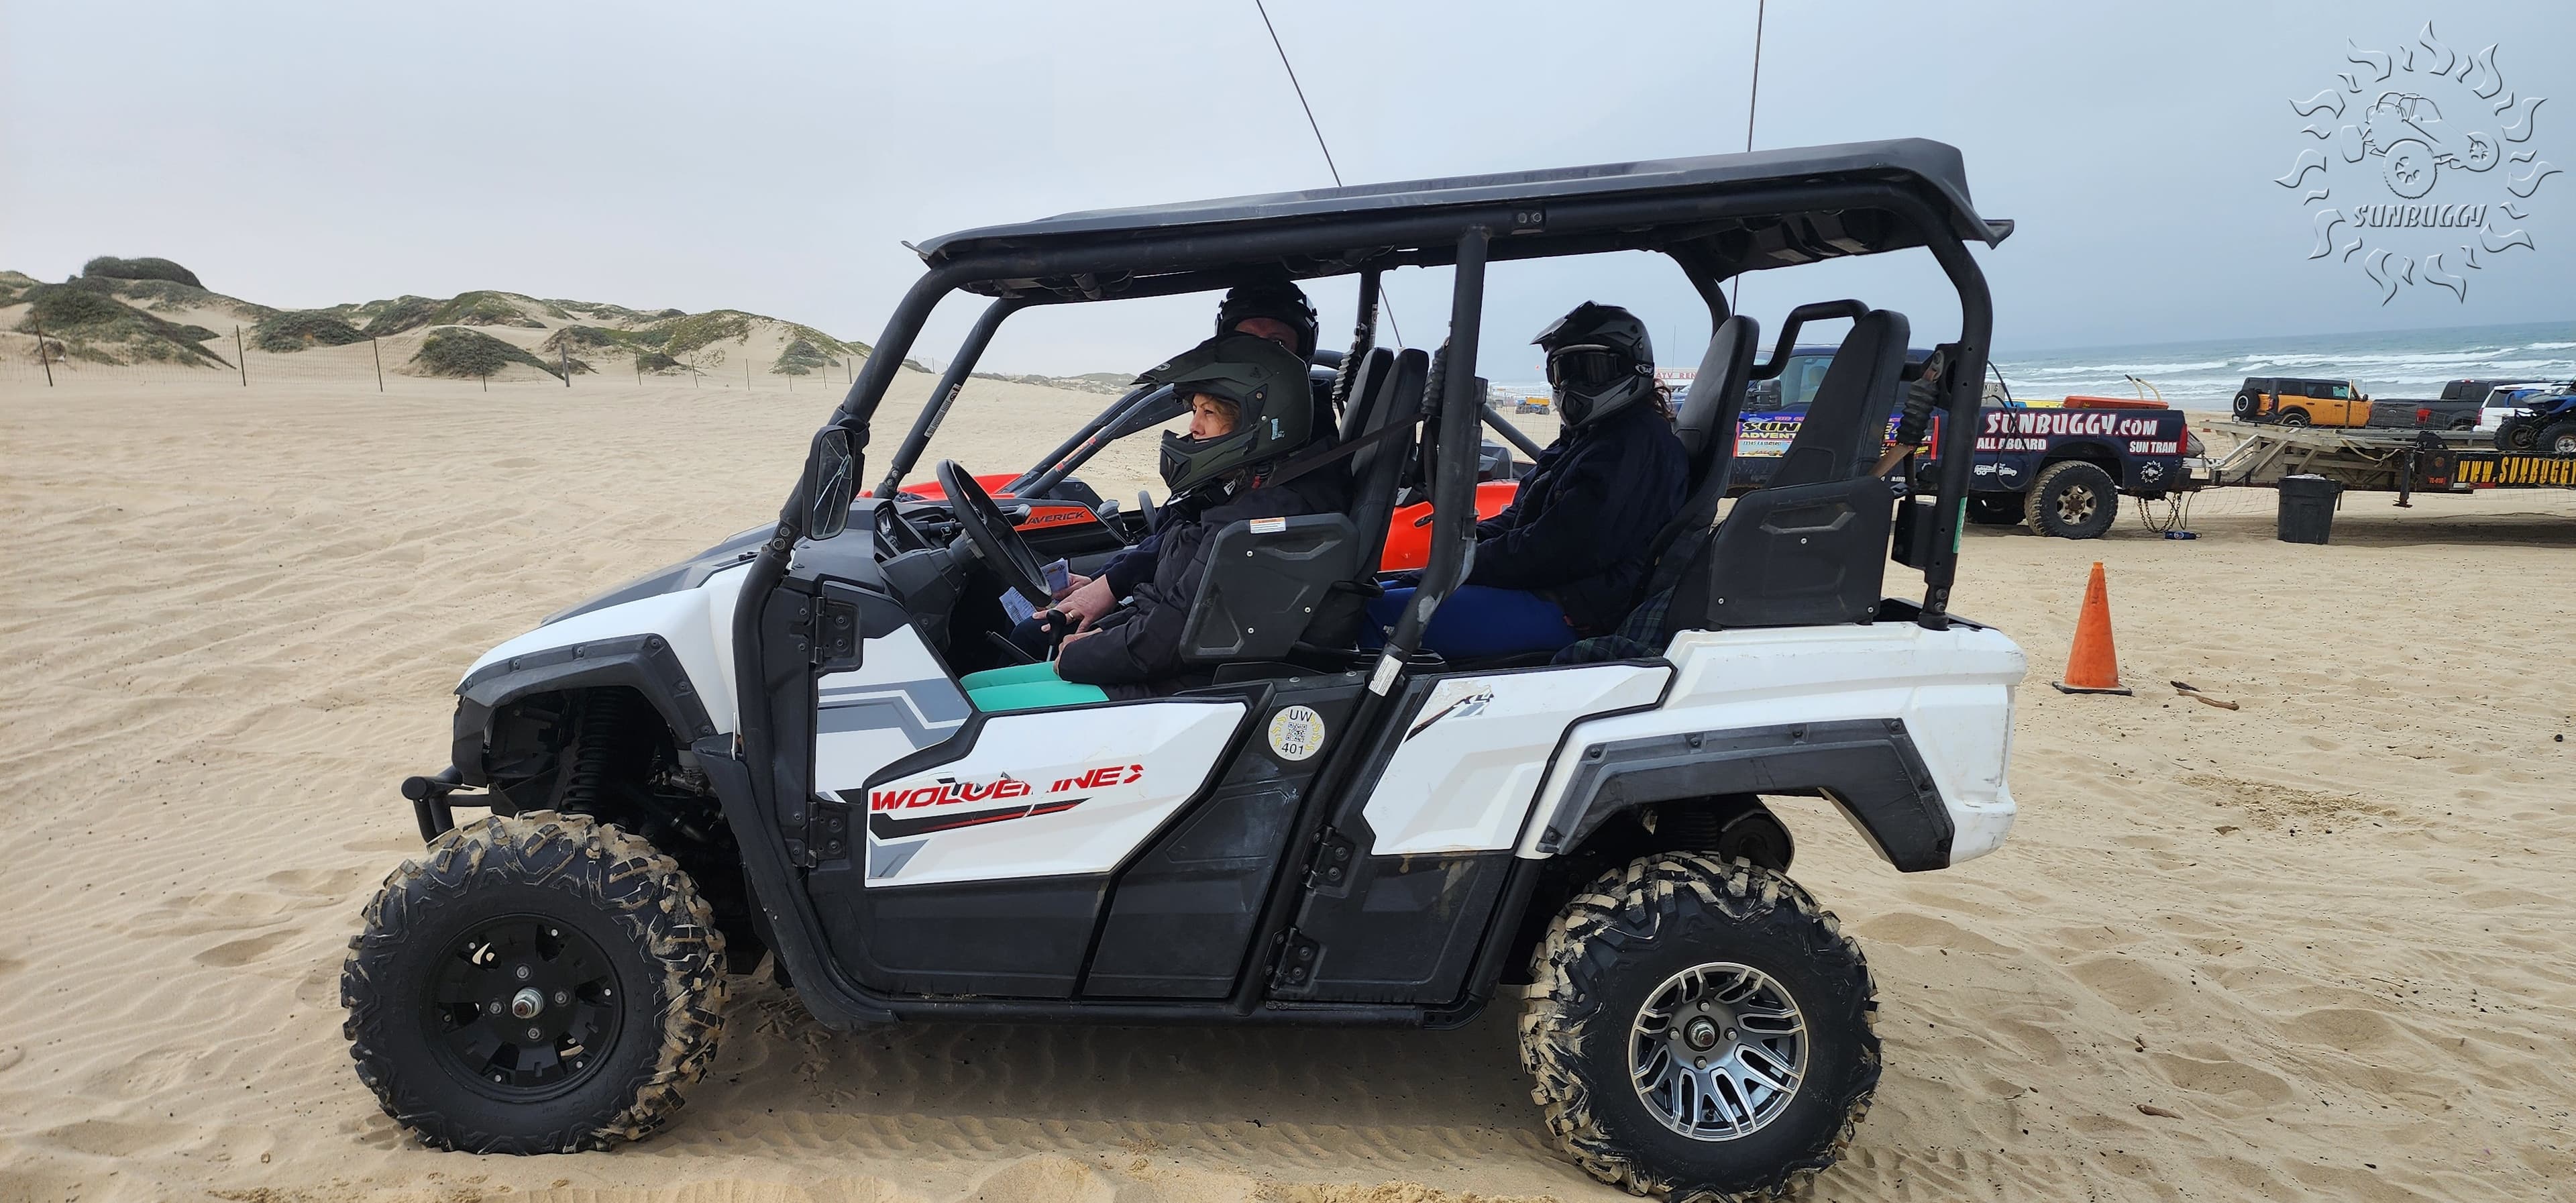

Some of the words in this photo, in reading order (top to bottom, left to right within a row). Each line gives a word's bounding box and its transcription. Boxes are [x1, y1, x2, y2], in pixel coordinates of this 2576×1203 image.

[1976, 437, 1996, 450] ALL
[1998, 438, 2047, 451] ABOARD
[2129, 441, 2149, 453] SUN
[2151, 441, 2178, 454] TRAM
[1289, 709, 1313, 722] UW
[1281, 742, 1303, 755] 401
